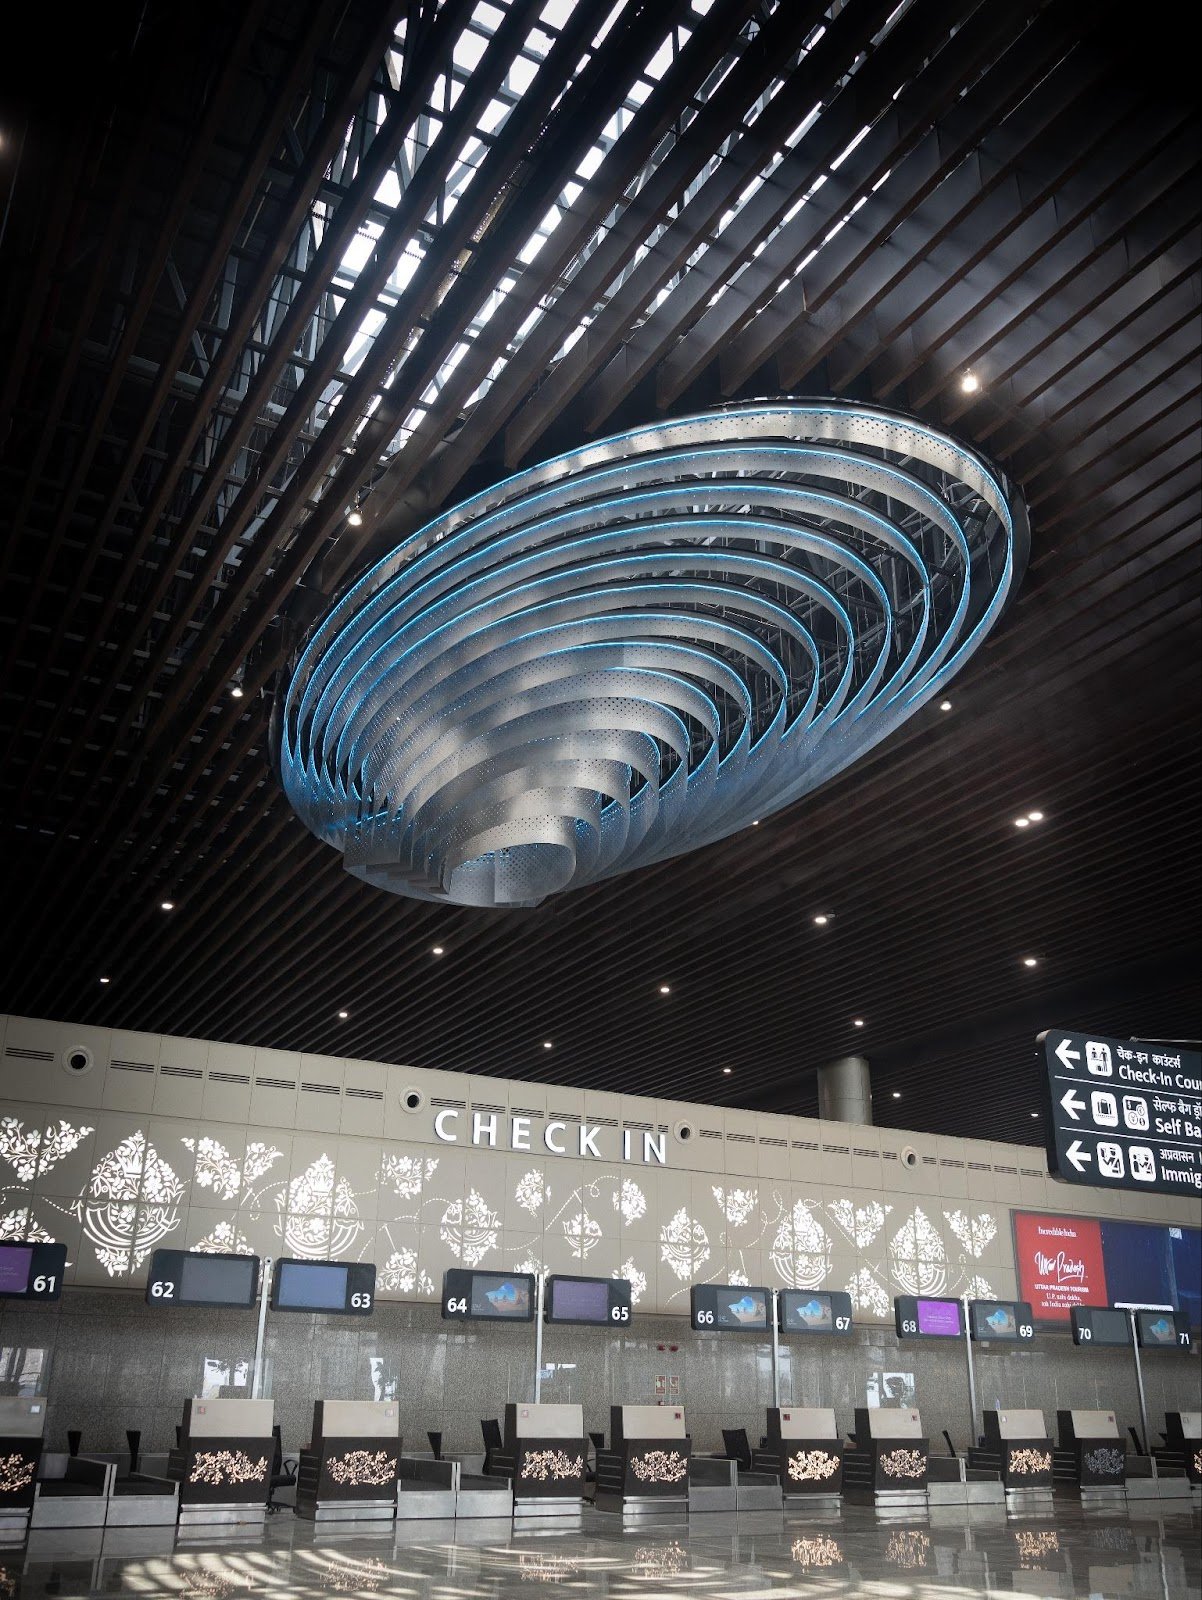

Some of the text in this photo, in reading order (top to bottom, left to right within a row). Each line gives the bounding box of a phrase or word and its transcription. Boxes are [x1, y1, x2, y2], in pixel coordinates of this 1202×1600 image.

[1116, 1046, 1148, 1064] चेक-इन
[1118, 1065, 1172, 1087] Check-In
[1153, 1096, 1177, 1113] सेल्फ
[1178, 1098, 1192, 1115] बैग
[1155, 1117, 1182, 1136] Self
[434, 1109, 667, 1165] CHECK IN
[1159, 1148, 1195, 1163] अप्रवासन
[33, 1275, 56, 1293] 61
[151, 1281, 175, 1299] 62
[350, 1292, 372, 1309] 63
[446, 1297, 468, 1314] 64
[611, 1306, 630, 1321] 65
[697, 1310, 714, 1325] 66
[835, 1316, 851, 1331] 67
[902, 1320, 917, 1333] 68
[1019, 1325, 1033, 1338] 69
[1078, 1327, 1092, 1340] 70
[1179, 1332, 1190, 1345] 71
